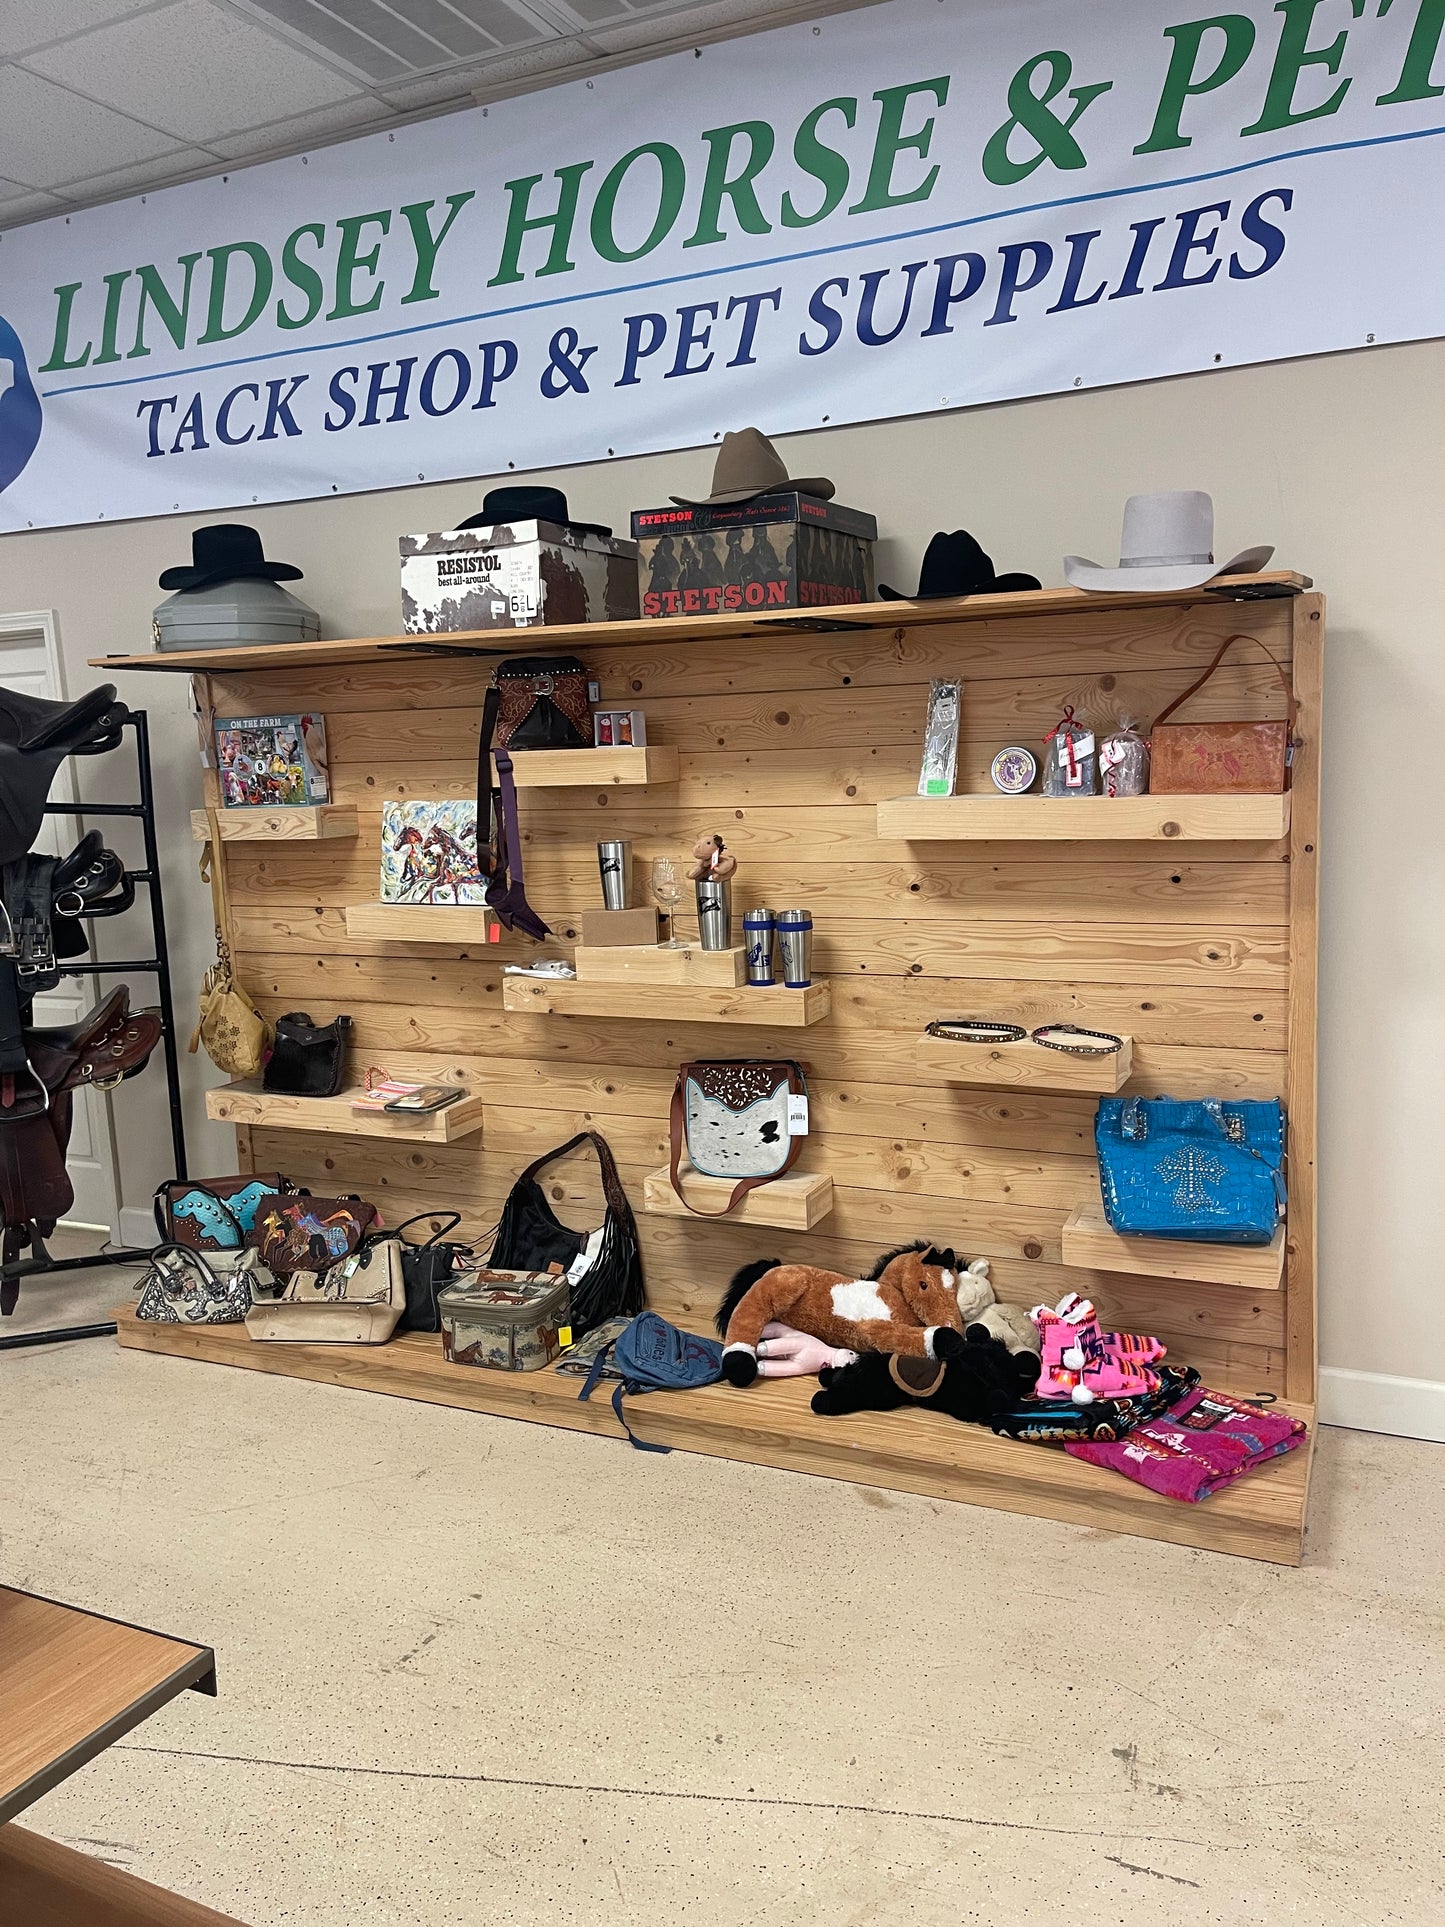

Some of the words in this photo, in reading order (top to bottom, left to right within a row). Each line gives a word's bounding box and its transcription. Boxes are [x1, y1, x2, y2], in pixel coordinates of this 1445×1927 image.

[38, 191, 475, 373] LINDSEY
[487, 76, 951, 288] HORSE
[981, 50, 1113, 186] &
[1133, 0, 1445, 156] PET
[137, 374, 309, 459] TACK
[324, 340, 519, 432] SHOP
[539, 327, 599, 399] &
[615, 288, 783, 388] PET
[799, 188, 1294, 357] SUPPLIES
[639, 511, 693, 526] STETSON
[436, 555, 501, 576] RESISTOL
[437, 577, 453, 587] best
[453, 573, 490, 586] all-around
[643, 580, 788, 616] STETSON
[800, 580, 862, 606] STETSON
[230, 720, 241, 729] ON
[243, 719, 258, 728] THE
[259, 718, 281, 727] FARM
[257, 762, 263, 771] 8
